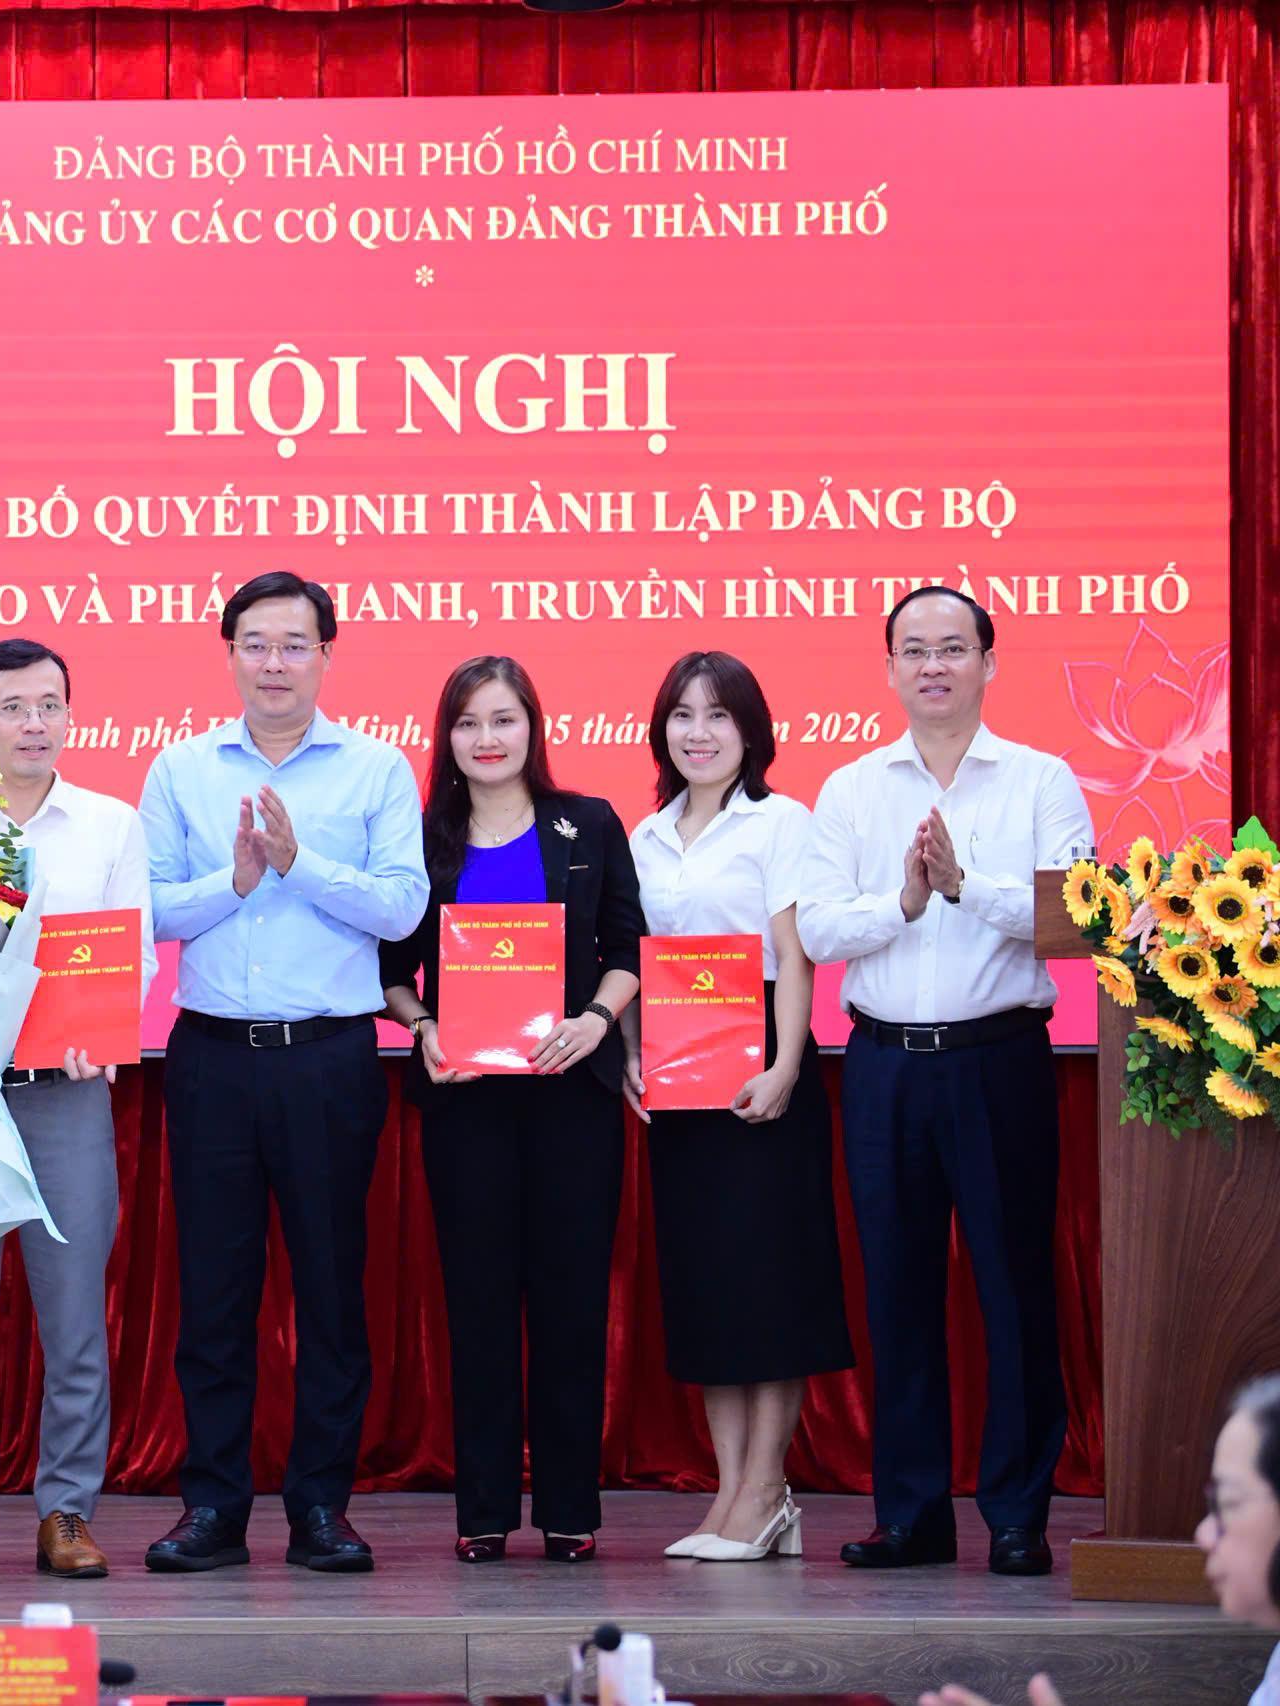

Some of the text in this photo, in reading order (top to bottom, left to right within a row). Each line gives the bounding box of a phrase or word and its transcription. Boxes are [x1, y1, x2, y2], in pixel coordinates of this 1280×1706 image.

[53, 123, 788, 186] ĐẢNG BỘ THÀNH PHỐ HỒ CHÍ MINH
[99, 197, 158, 245] ỦY
[171, 197, 262, 245] CÁC
[274, 202, 338, 244] CƠ
[348, 207, 474, 250] QUAN
[486, 193, 611, 240] ĐẢNG
[623, 192, 781, 238] THÀNH
[795, 182, 888, 236] PHỐ
[164, 342, 677, 459] HỘI NGHỊ
[5, 483, 79, 539] BỐ
[93, 482, 280, 546] QUYẾT
[292, 493, 429, 546] ĐỊNH
[442, 480, 635, 534] THÀNH
[652, 482, 757, 543] LẬP
[767, 476, 925, 530] ĐẢNG
[941, 479, 1017, 539] BỘ
[40, 572, 113, 625] VÀ
[127, 571, 246, 624] PHÁ
[332, 581, 479, 628] HANH,
[491, 567, 706, 621] TRUYỀN
[723, 566, 858, 618] HÌNH
[1078, 563, 1190, 614] PHỐ
[63, 717, 121, 749] ành
[581, 712, 651, 745] thán
[799, 711, 882, 743] 2026
